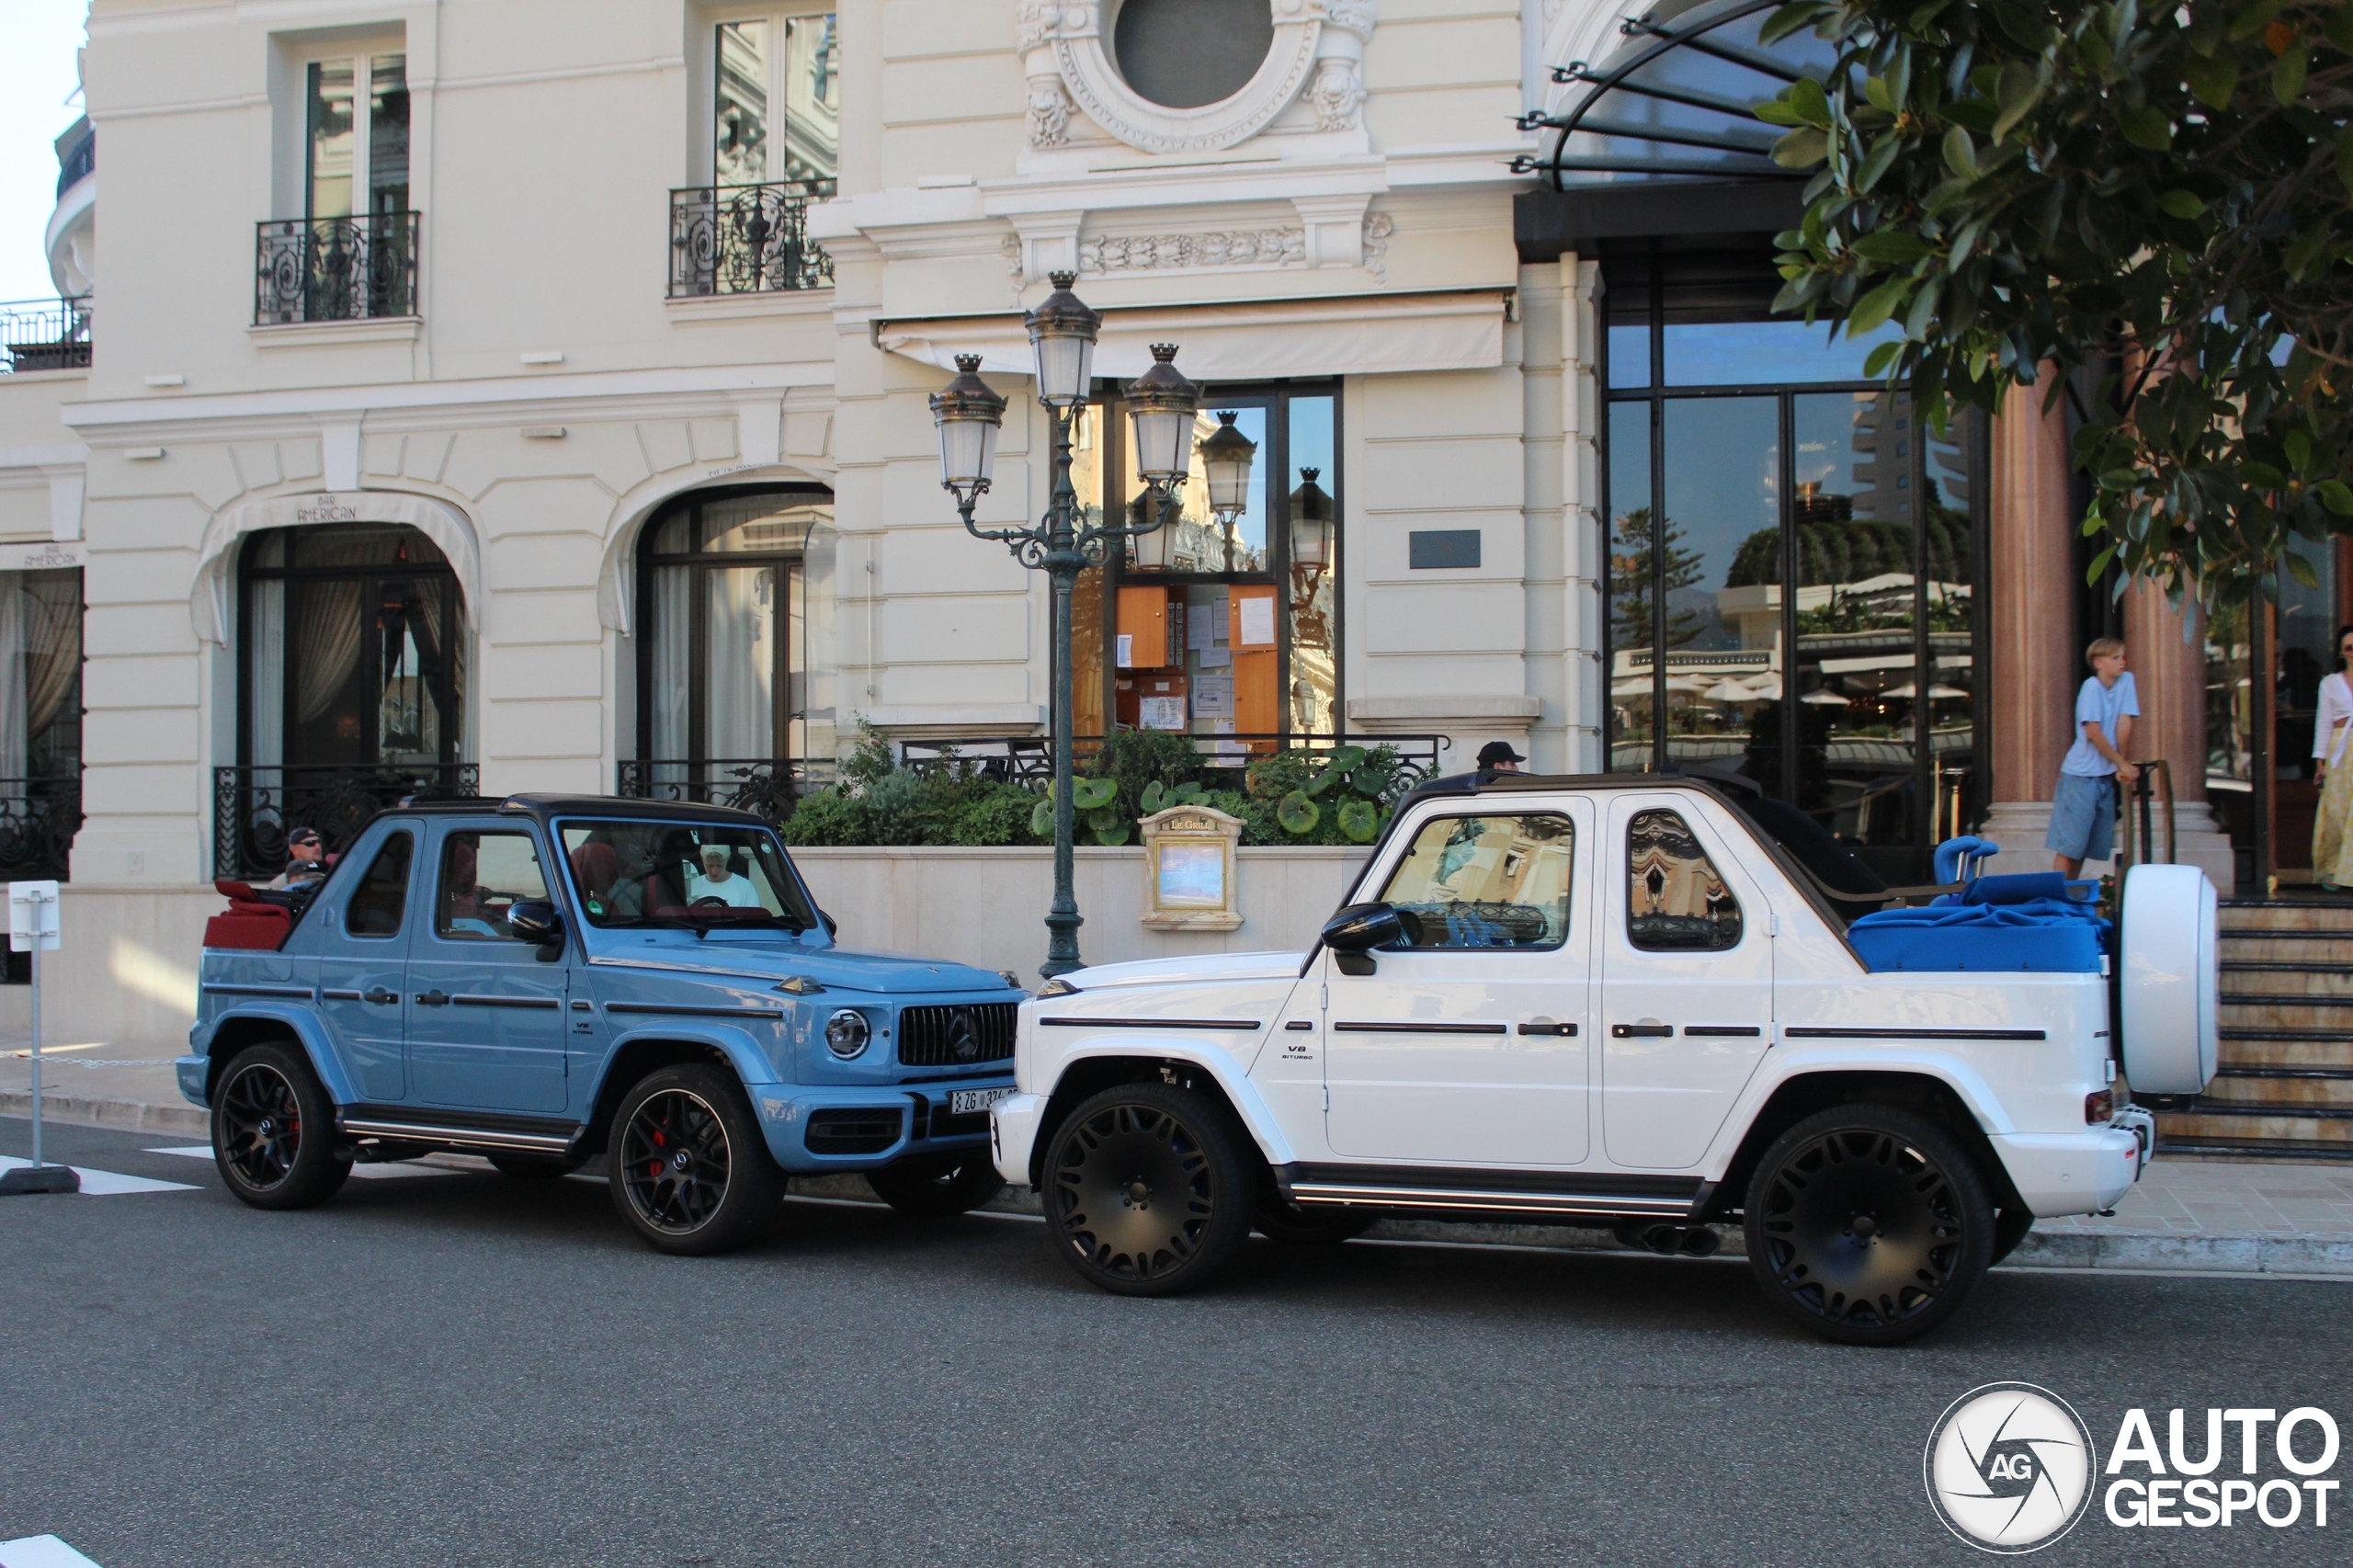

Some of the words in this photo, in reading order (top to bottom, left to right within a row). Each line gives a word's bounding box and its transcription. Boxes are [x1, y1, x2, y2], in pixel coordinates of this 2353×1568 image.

[317, 495, 335, 506] BAR
[297, 506, 357, 523] AMERICAIN
[964, 1092, 977, 1110] ZG
